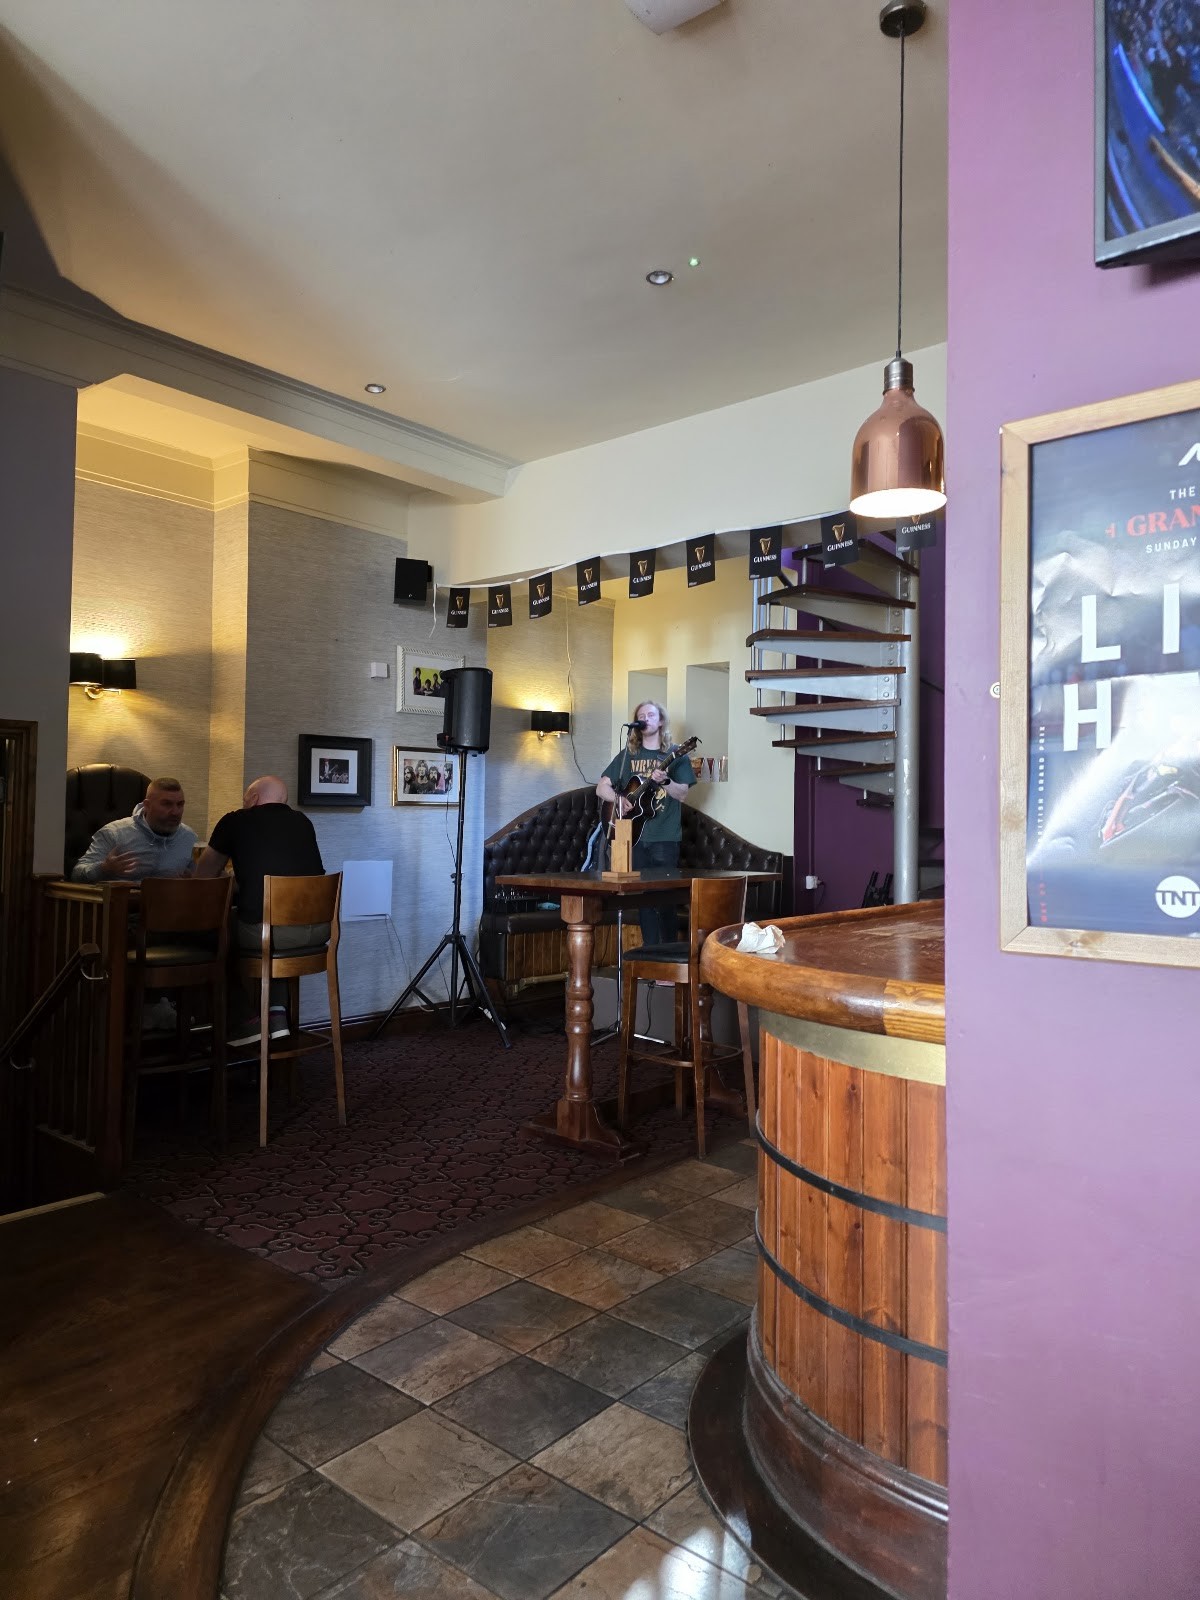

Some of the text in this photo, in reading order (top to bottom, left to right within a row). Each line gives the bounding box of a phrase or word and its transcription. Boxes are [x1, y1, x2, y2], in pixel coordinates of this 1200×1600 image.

[1169, 486, 1196, 500] THE
[901, 522, 931, 534] GUINNESS
[827, 540, 853, 552] GUINNESS
[1146, 537, 1197, 554] SUNDAY
[753, 553, 777, 563] GUINNESS
[690, 560, 712, 572] GUINNESS
[1156, 889, 1200, 907] TNT
